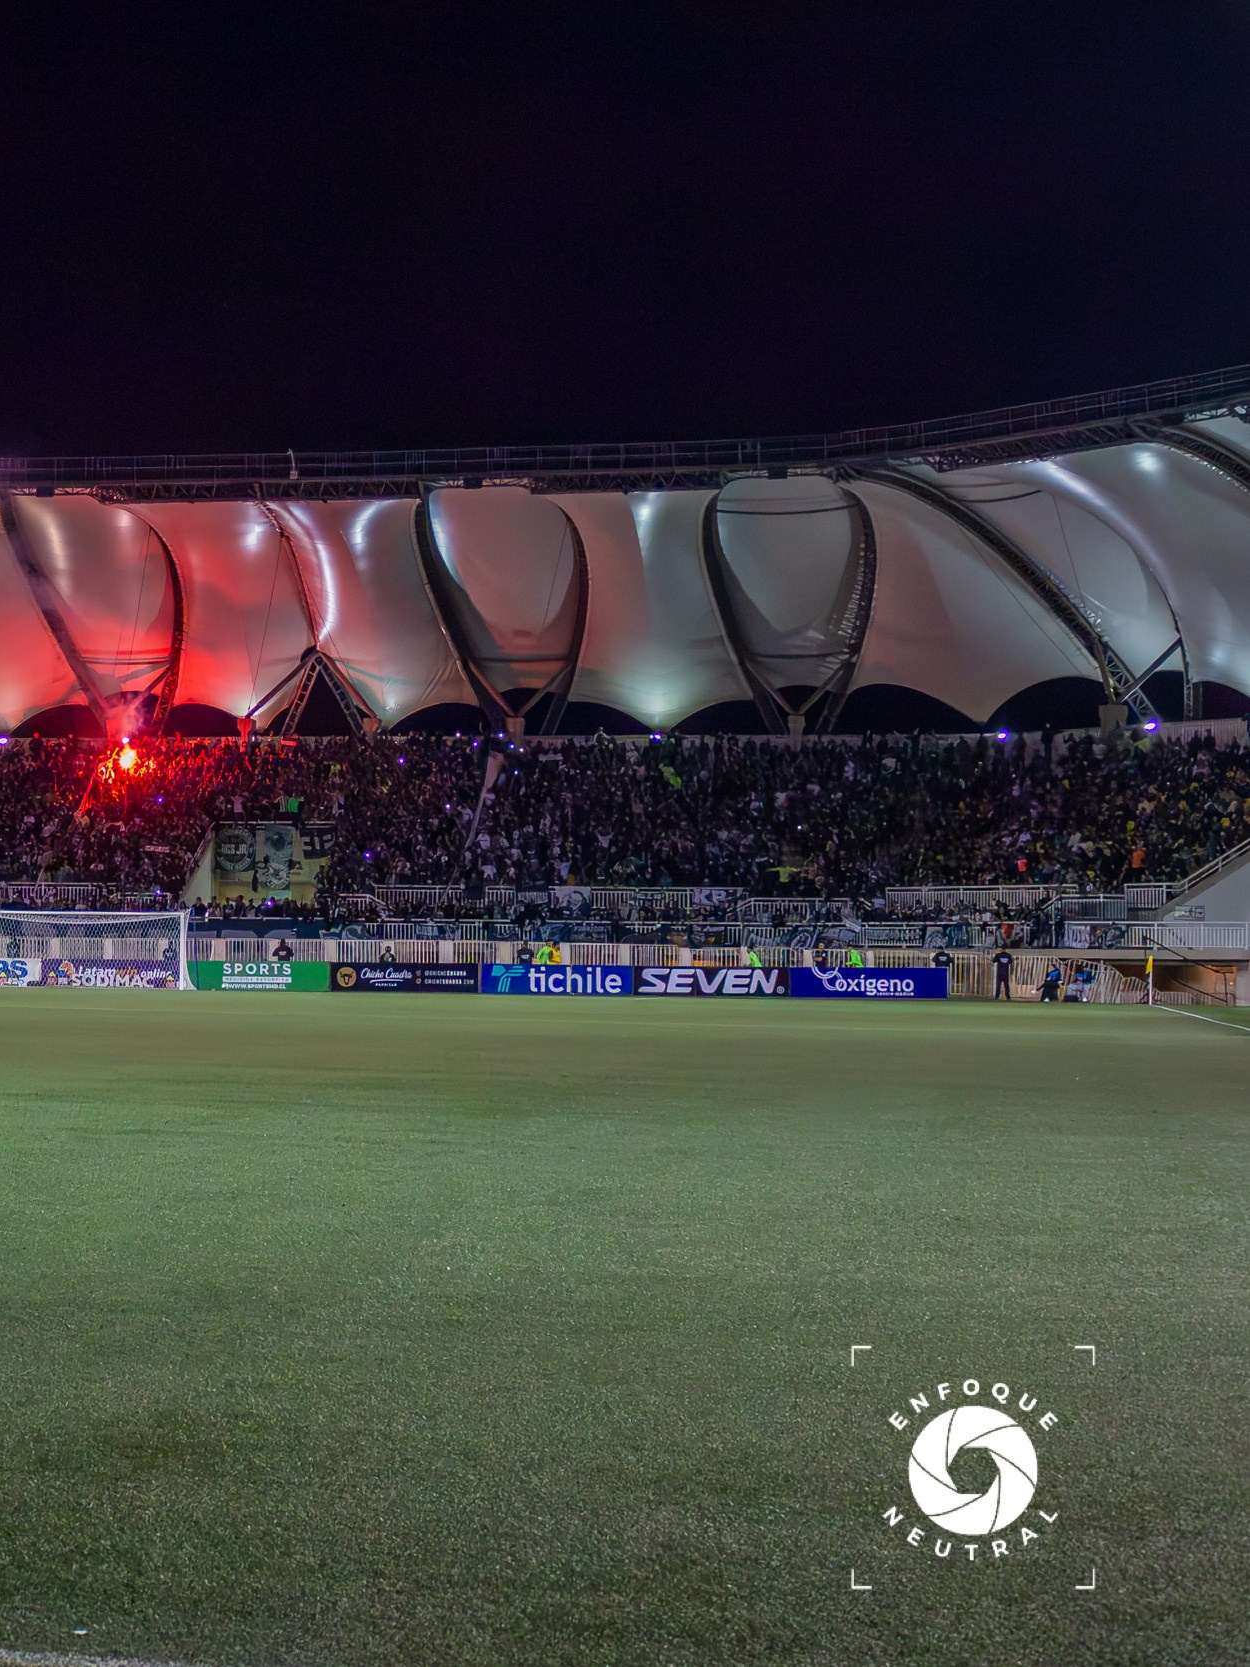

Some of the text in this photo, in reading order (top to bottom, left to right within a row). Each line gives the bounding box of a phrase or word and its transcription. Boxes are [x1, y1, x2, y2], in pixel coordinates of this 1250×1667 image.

[223, 963, 292, 975] SPORTS
[528, 967, 622, 993] tichile
[72, 974, 155, 987] SODIMAC
[638, 968, 778, 994] SEVEN
[835, 974, 915, 996] oxígeno
